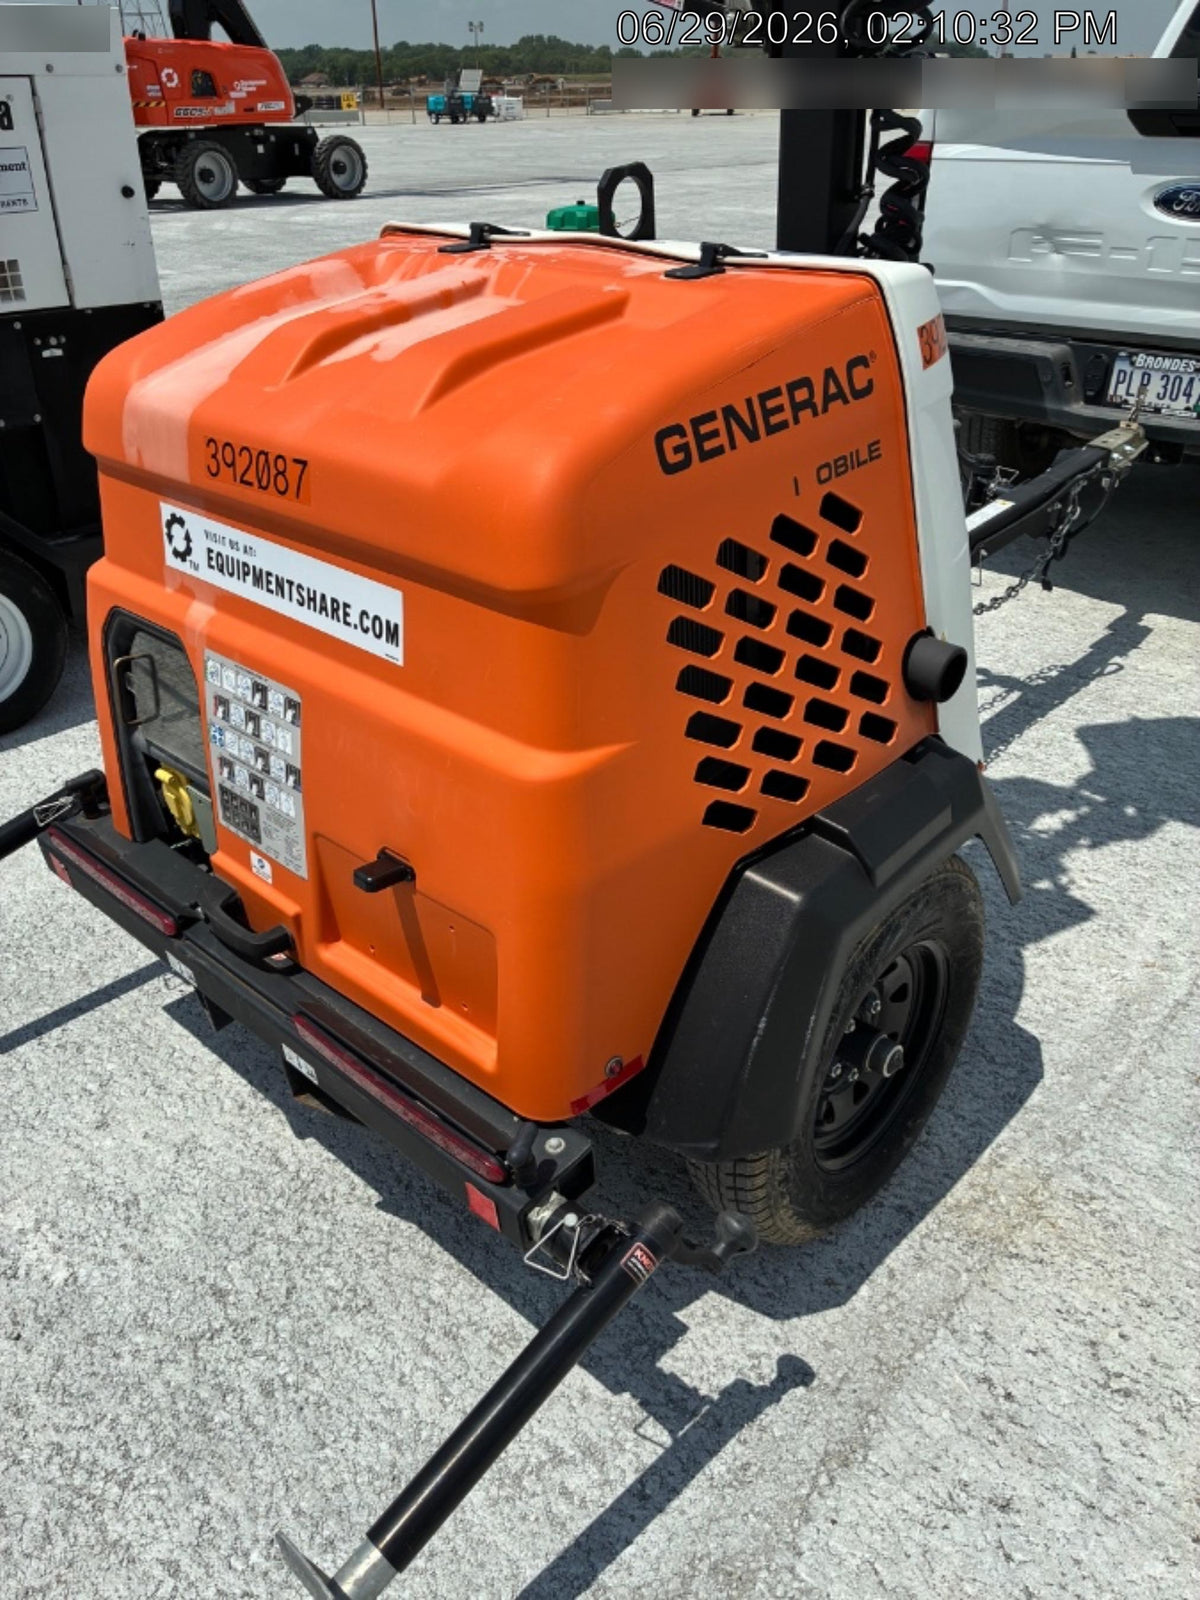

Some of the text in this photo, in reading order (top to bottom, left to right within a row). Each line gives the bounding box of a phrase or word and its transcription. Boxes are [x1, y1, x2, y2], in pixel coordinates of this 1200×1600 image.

[1135, 353, 1197, 373] BRONDES
[654, 354, 875, 476] GENERAC
[205, 437, 309, 500] 392087
[207, 546, 400, 649] EQUIPMENTSHARE.COM
